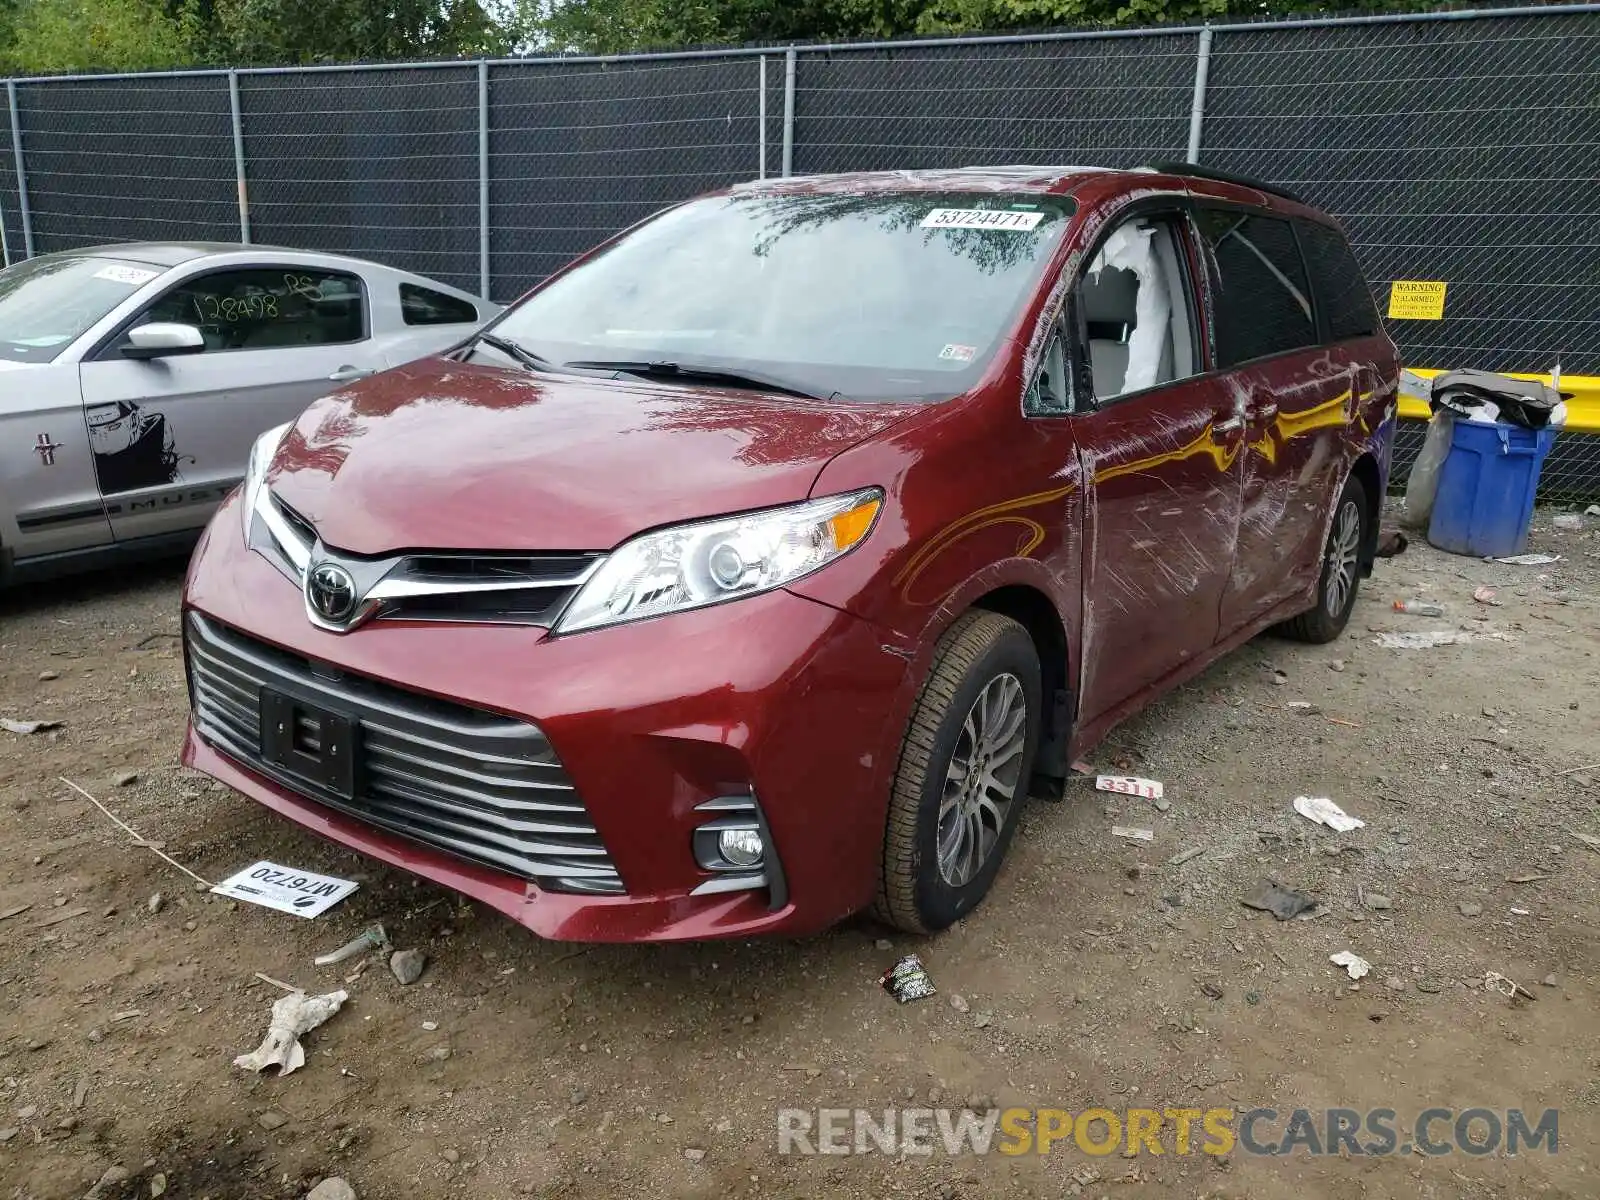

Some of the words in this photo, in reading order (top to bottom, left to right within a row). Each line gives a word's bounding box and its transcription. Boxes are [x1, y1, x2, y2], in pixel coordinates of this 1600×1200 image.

[1397, 283, 1442, 292] WARNING
[193, 294, 279, 322] 128498
[1102, 778, 1155, 800] 3311
[250, 867, 341, 897] M76720
